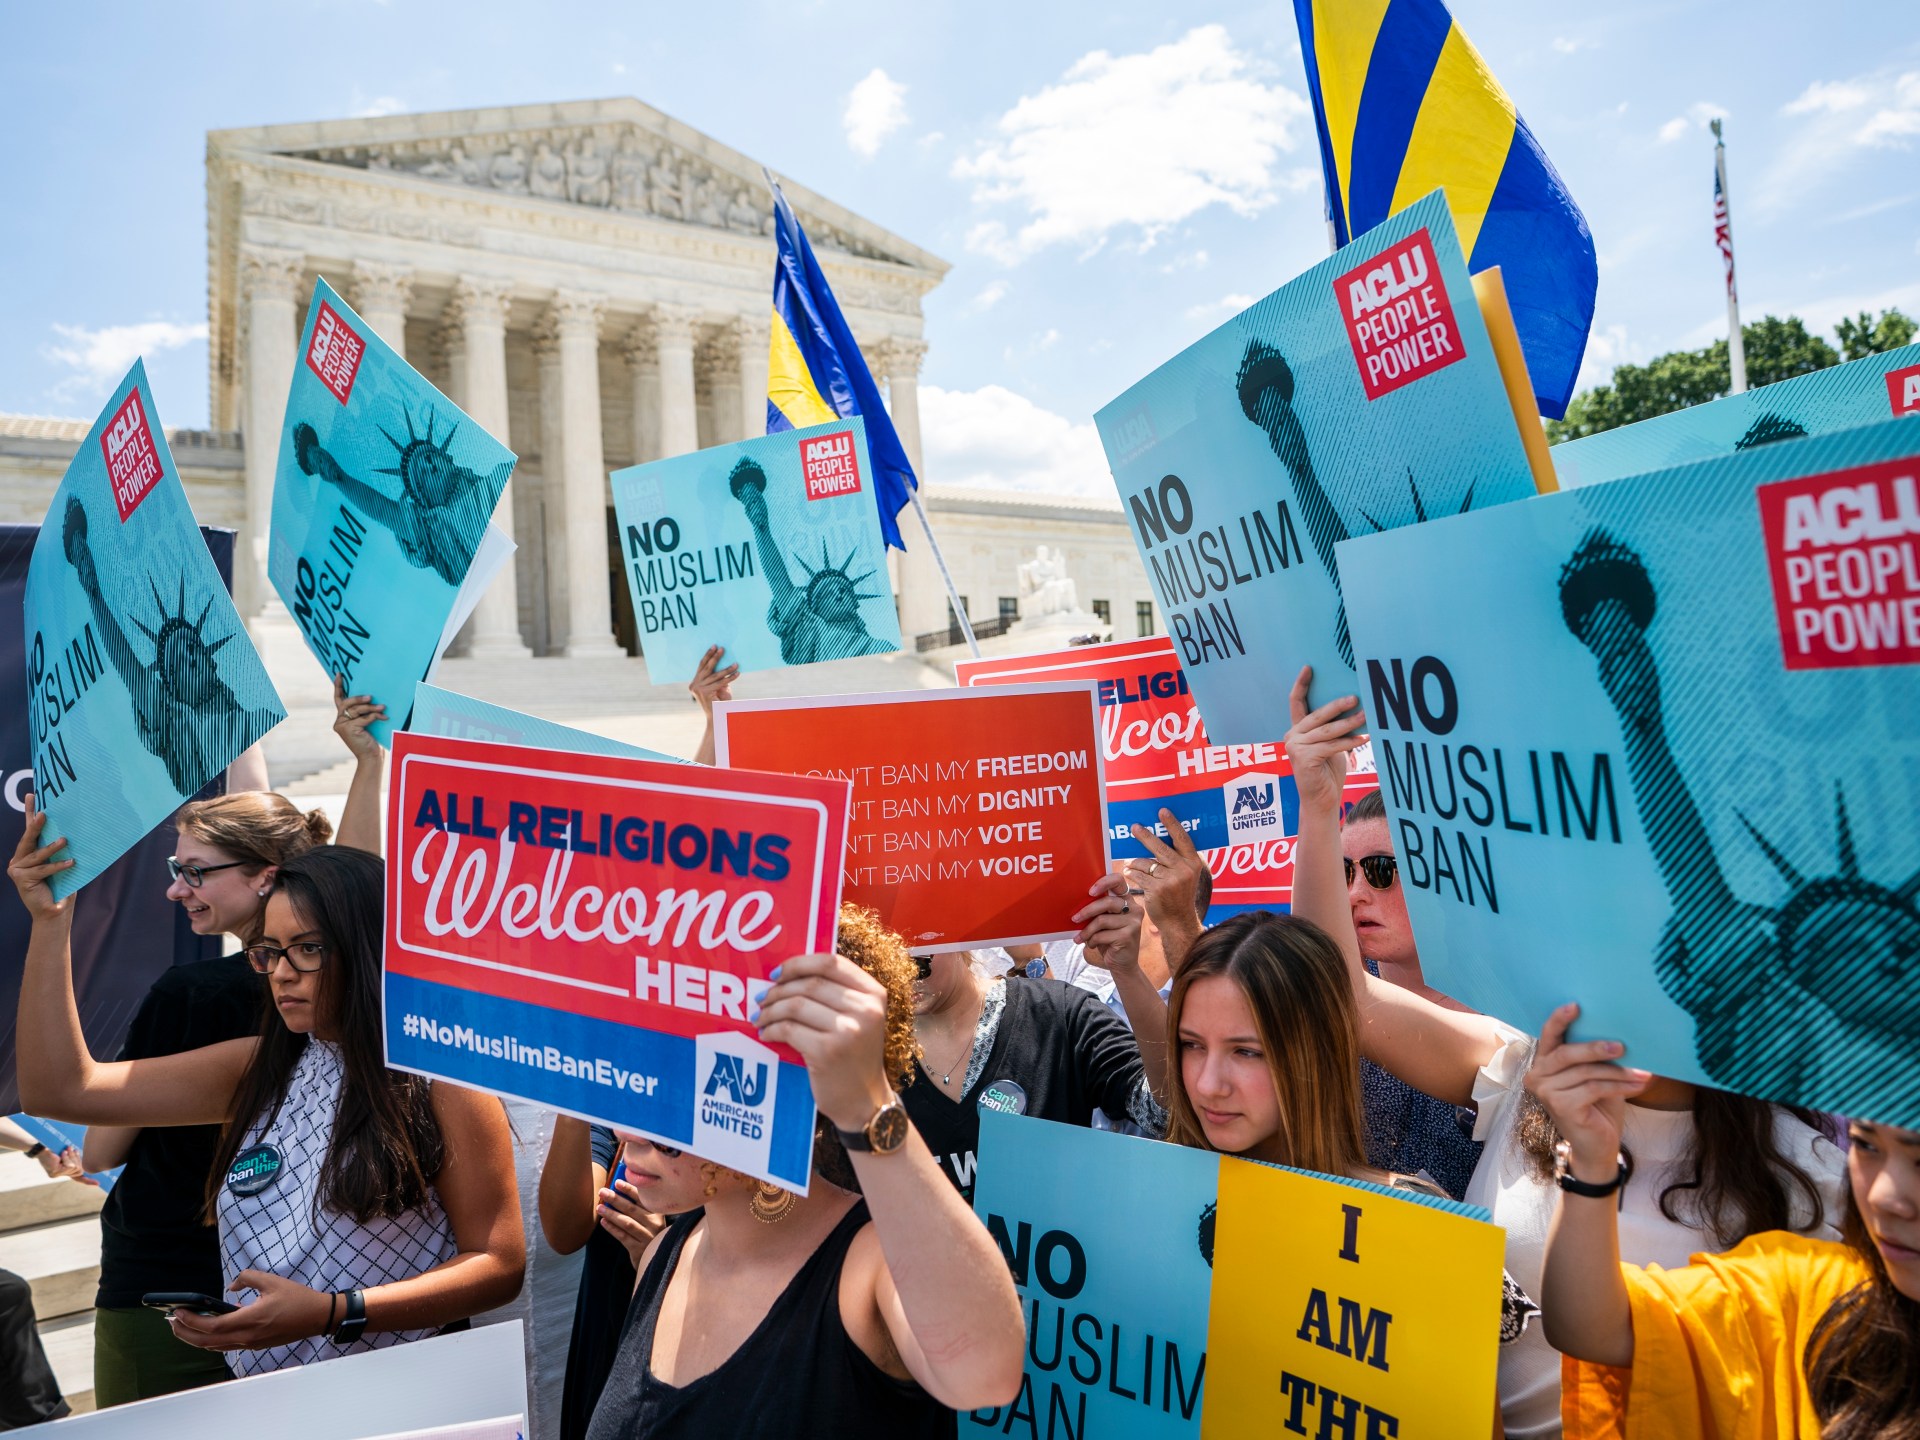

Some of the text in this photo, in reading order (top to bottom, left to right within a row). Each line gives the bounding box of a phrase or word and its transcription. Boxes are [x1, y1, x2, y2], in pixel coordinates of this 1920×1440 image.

[1349, 244, 1428, 320] ACLU
[311, 309, 336, 372] ACLU
[1355, 285, 1441, 353] PEOPLE
[322, 323, 349, 384] PEOPLE
[333, 337, 361, 397] POWER
[1366, 322, 1453, 387] POWER
[106, 399, 141, 463] ACLU
[112, 426, 149, 488] PEOPLE
[807, 437, 850, 462] ACLU
[118, 453, 157, 512] POWER
[807, 456, 853, 479] PEOPLE
[810, 473, 856, 495] POWER
[627, 517, 680, 559] NO
[1129, 474, 1193, 550] NO
[633, 541, 755, 597] MUSLIM
[1150, 499, 1304, 608] MUSLIM
[1785, 542, 1920, 603] PEOPL
[294, 556, 316, 637] NO
[312, 503, 367, 667] MUSLIM
[640, 592, 698, 634] BAN
[1171, 598, 1246, 667] BAN
[1794, 597, 1920, 654] POWE
[28, 630, 45, 712] NO
[1366, 655, 1459, 736] NO
[881, 762, 928, 786] BAN
[936, 759, 970, 782] MY
[977, 749, 1088, 778] FREEDOM
[1177, 742, 1277, 777] HERE
[882, 796, 930, 819] BAN
[937, 793, 971, 815] MY
[978, 784, 1072, 812] DIGNITY
[1232, 782, 1275, 815] AU
[1232, 810, 1277, 823] AMERICANS
[1382, 739, 1623, 844] MUSLIM
[413, 789, 792, 883] ALL RELIGIONS
[883, 830, 931, 852] BAN
[938, 827, 973, 849] MY
[978, 821, 1043, 845] VOTE
[1232, 816, 1277, 831] UNITED
[411, 822, 782, 952] Welcome
[884, 863, 931, 885] BAN
[939, 859, 973, 881] MY
[978, 853, 1054, 877] VOICE
[1398, 817, 1500, 915] BAN
[403, 1013, 659, 1097] #NoMuslimBanEver
[703, 1051, 768, 1107] AU
[701, 1108, 763, 1140] UNITED
[702, 1098, 764, 1125] AMERICANS
[988, 1088, 1018, 1109] can't
[234, 1152, 268, 1172] can't
[987, 1213, 1087, 1300] NO
[1338, 1203, 1362, 1264] I
[1017, 1294, 1207, 1421] USLIM
[1296, 1287, 1393, 1373] AM
